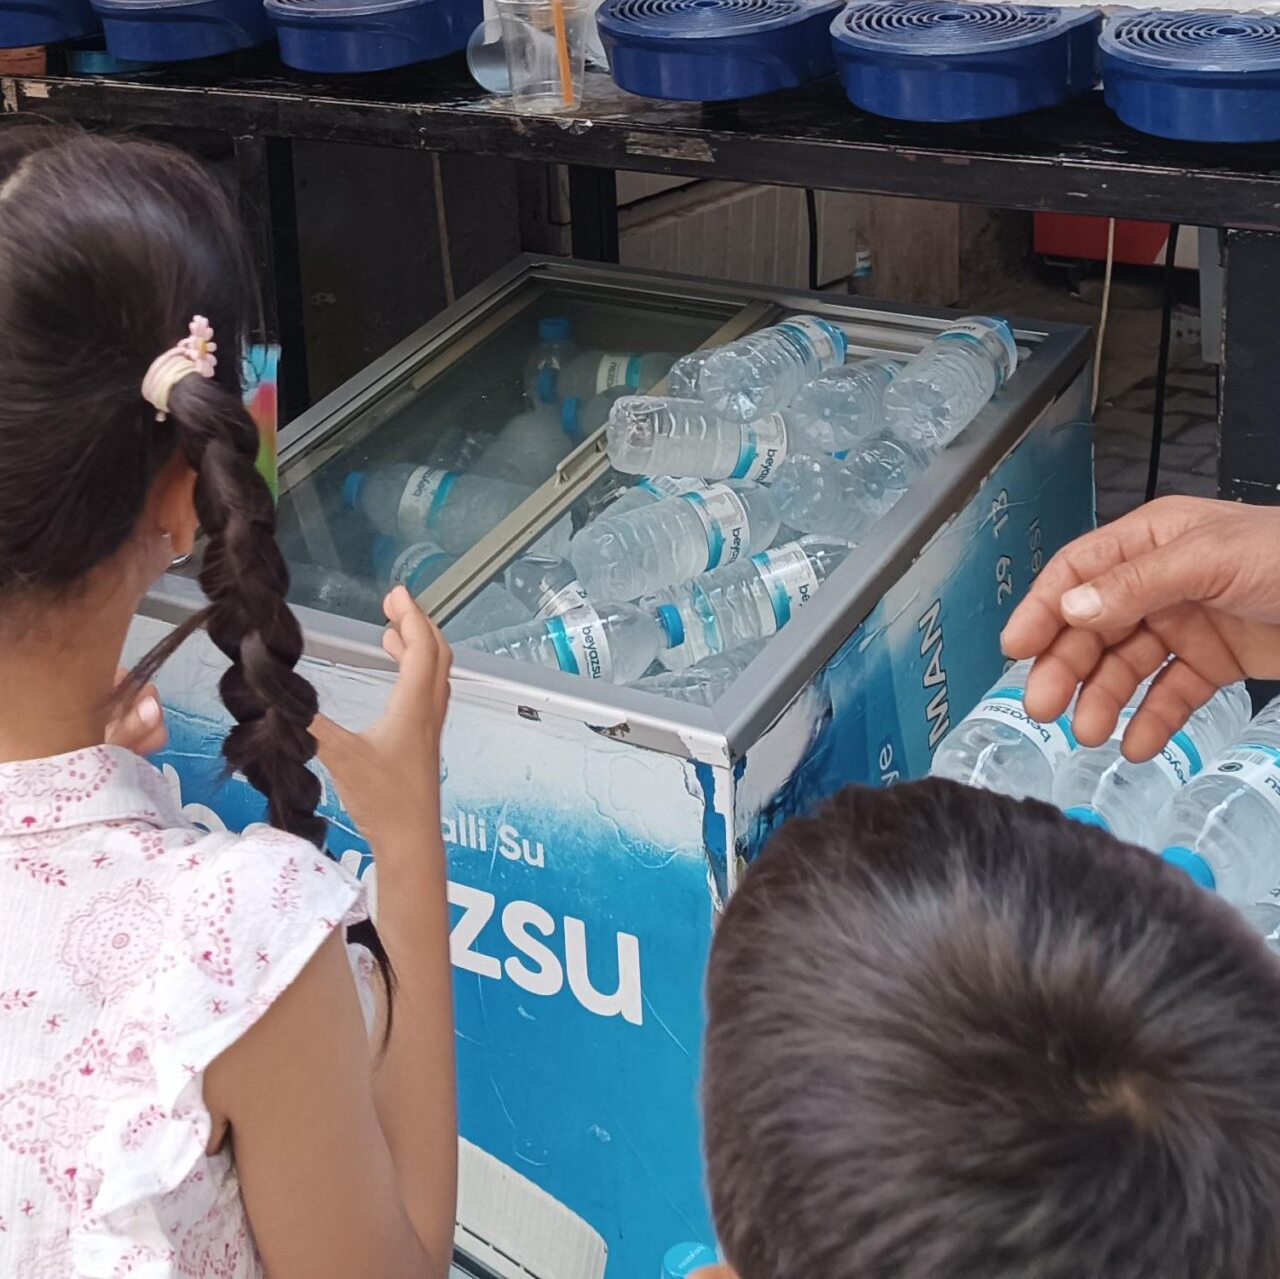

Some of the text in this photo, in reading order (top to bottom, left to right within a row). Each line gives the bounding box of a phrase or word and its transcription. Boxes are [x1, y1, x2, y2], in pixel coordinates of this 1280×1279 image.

[581, 624, 602, 680] beyazsu
[442, 814, 546, 869] alli Su
[447, 879, 643, 1026] zsu
